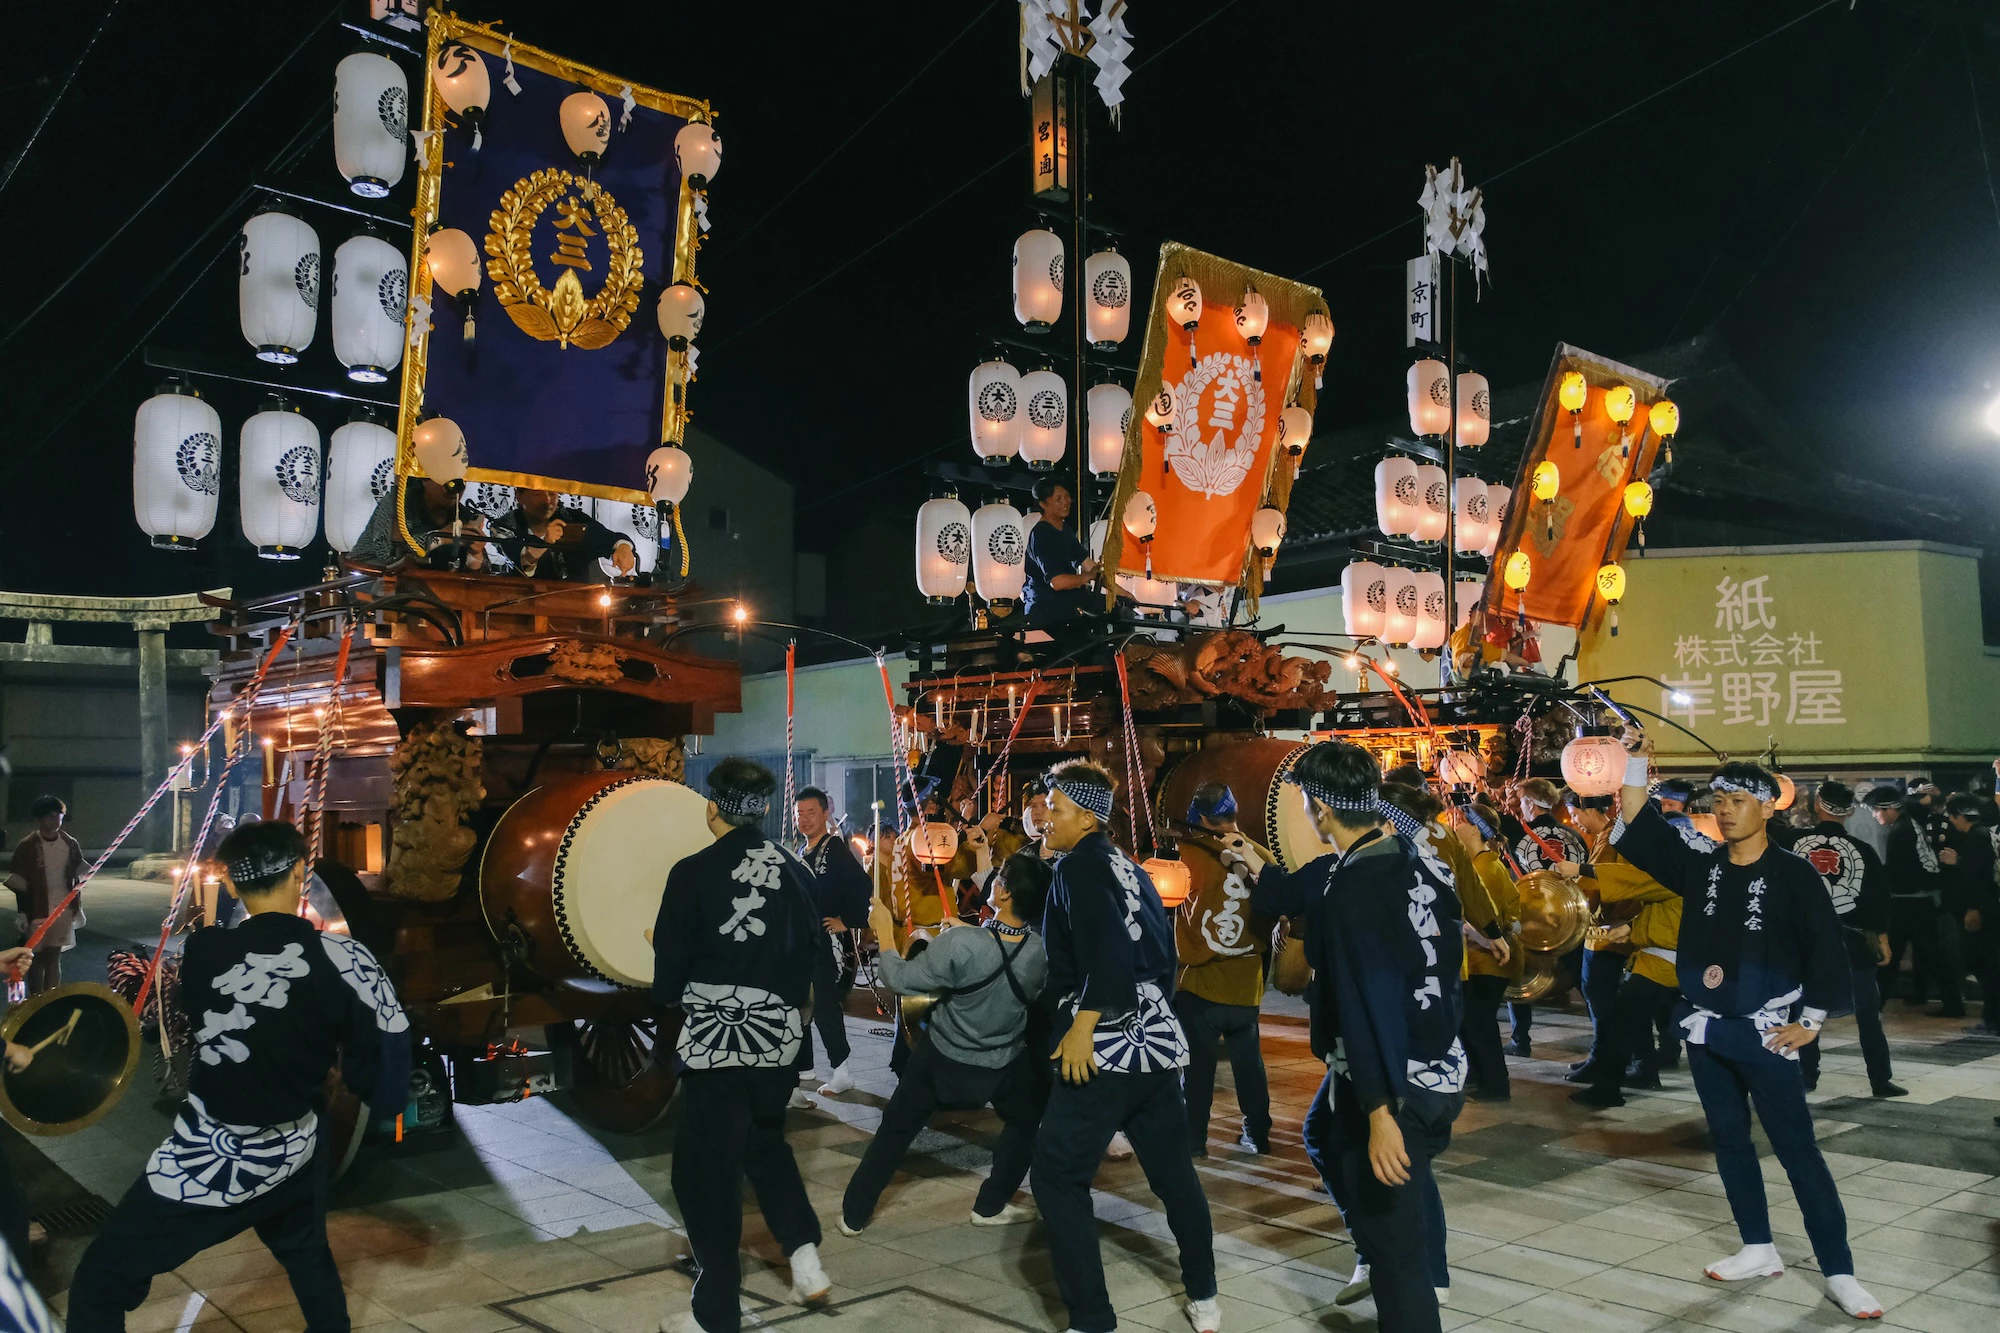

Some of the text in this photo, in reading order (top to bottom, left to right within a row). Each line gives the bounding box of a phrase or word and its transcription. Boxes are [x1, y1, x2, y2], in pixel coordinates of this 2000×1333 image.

[1038, 121, 1054, 176] 宮通
[550, 195, 598, 272] 大三
[1410, 280, 1429, 329] 京町
[991, 388, 1005, 403] 大
[1042, 397, 1056, 409] 三
[1208, 369, 1240, 431] 大三
[952, 529, 964, 545] 大
[1002, 532, 1016, 545] 三
[1715, 575, 1777, 632] 紙
[1673, 631, 1825, 669] 株式会社
[1657, 669, 1847, 728] 岸野屋
